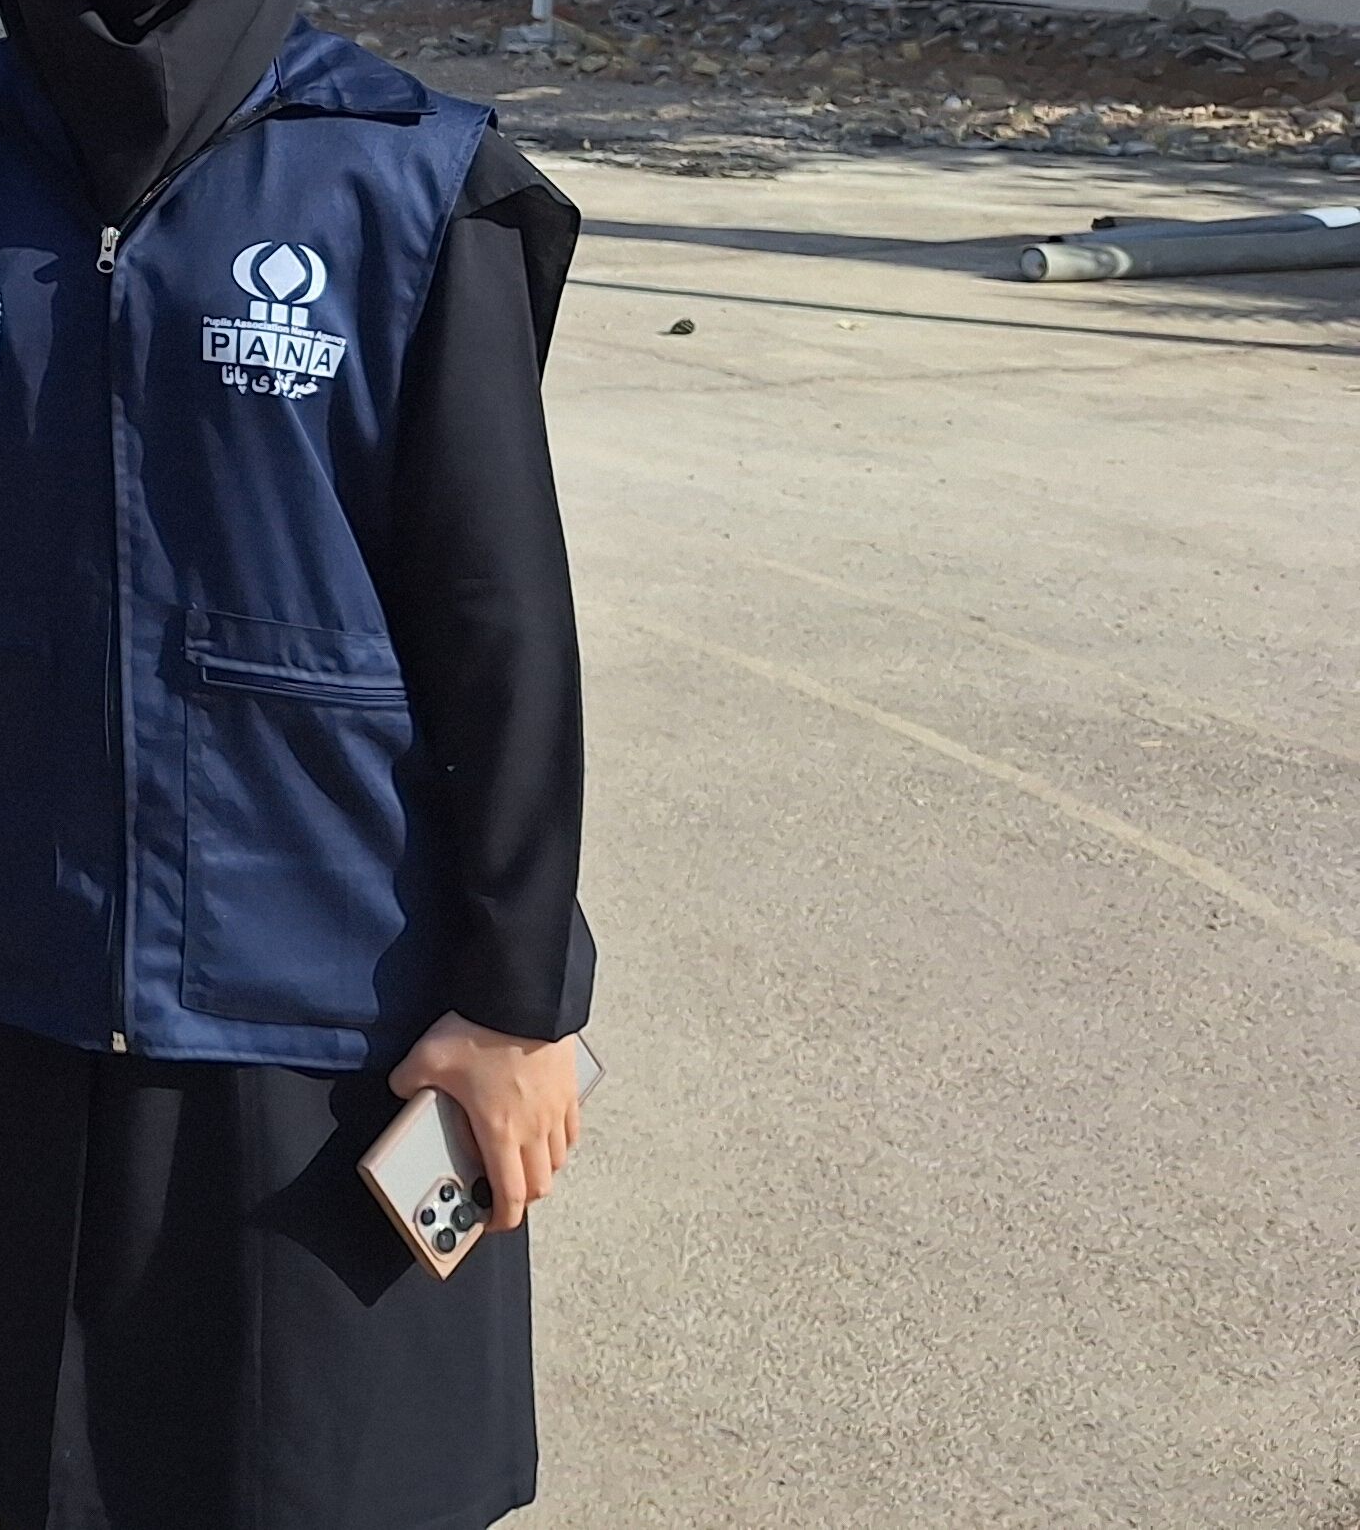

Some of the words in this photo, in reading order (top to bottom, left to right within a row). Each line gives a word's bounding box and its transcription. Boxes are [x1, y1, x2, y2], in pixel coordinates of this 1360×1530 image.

[233, 318, 290, 334] Association
[290, 326, 315, 339] News
[314, 330, 347, 347] Agency
[207, 330, 337, 374] PANA
[221, 364, 249, 395] پانا
